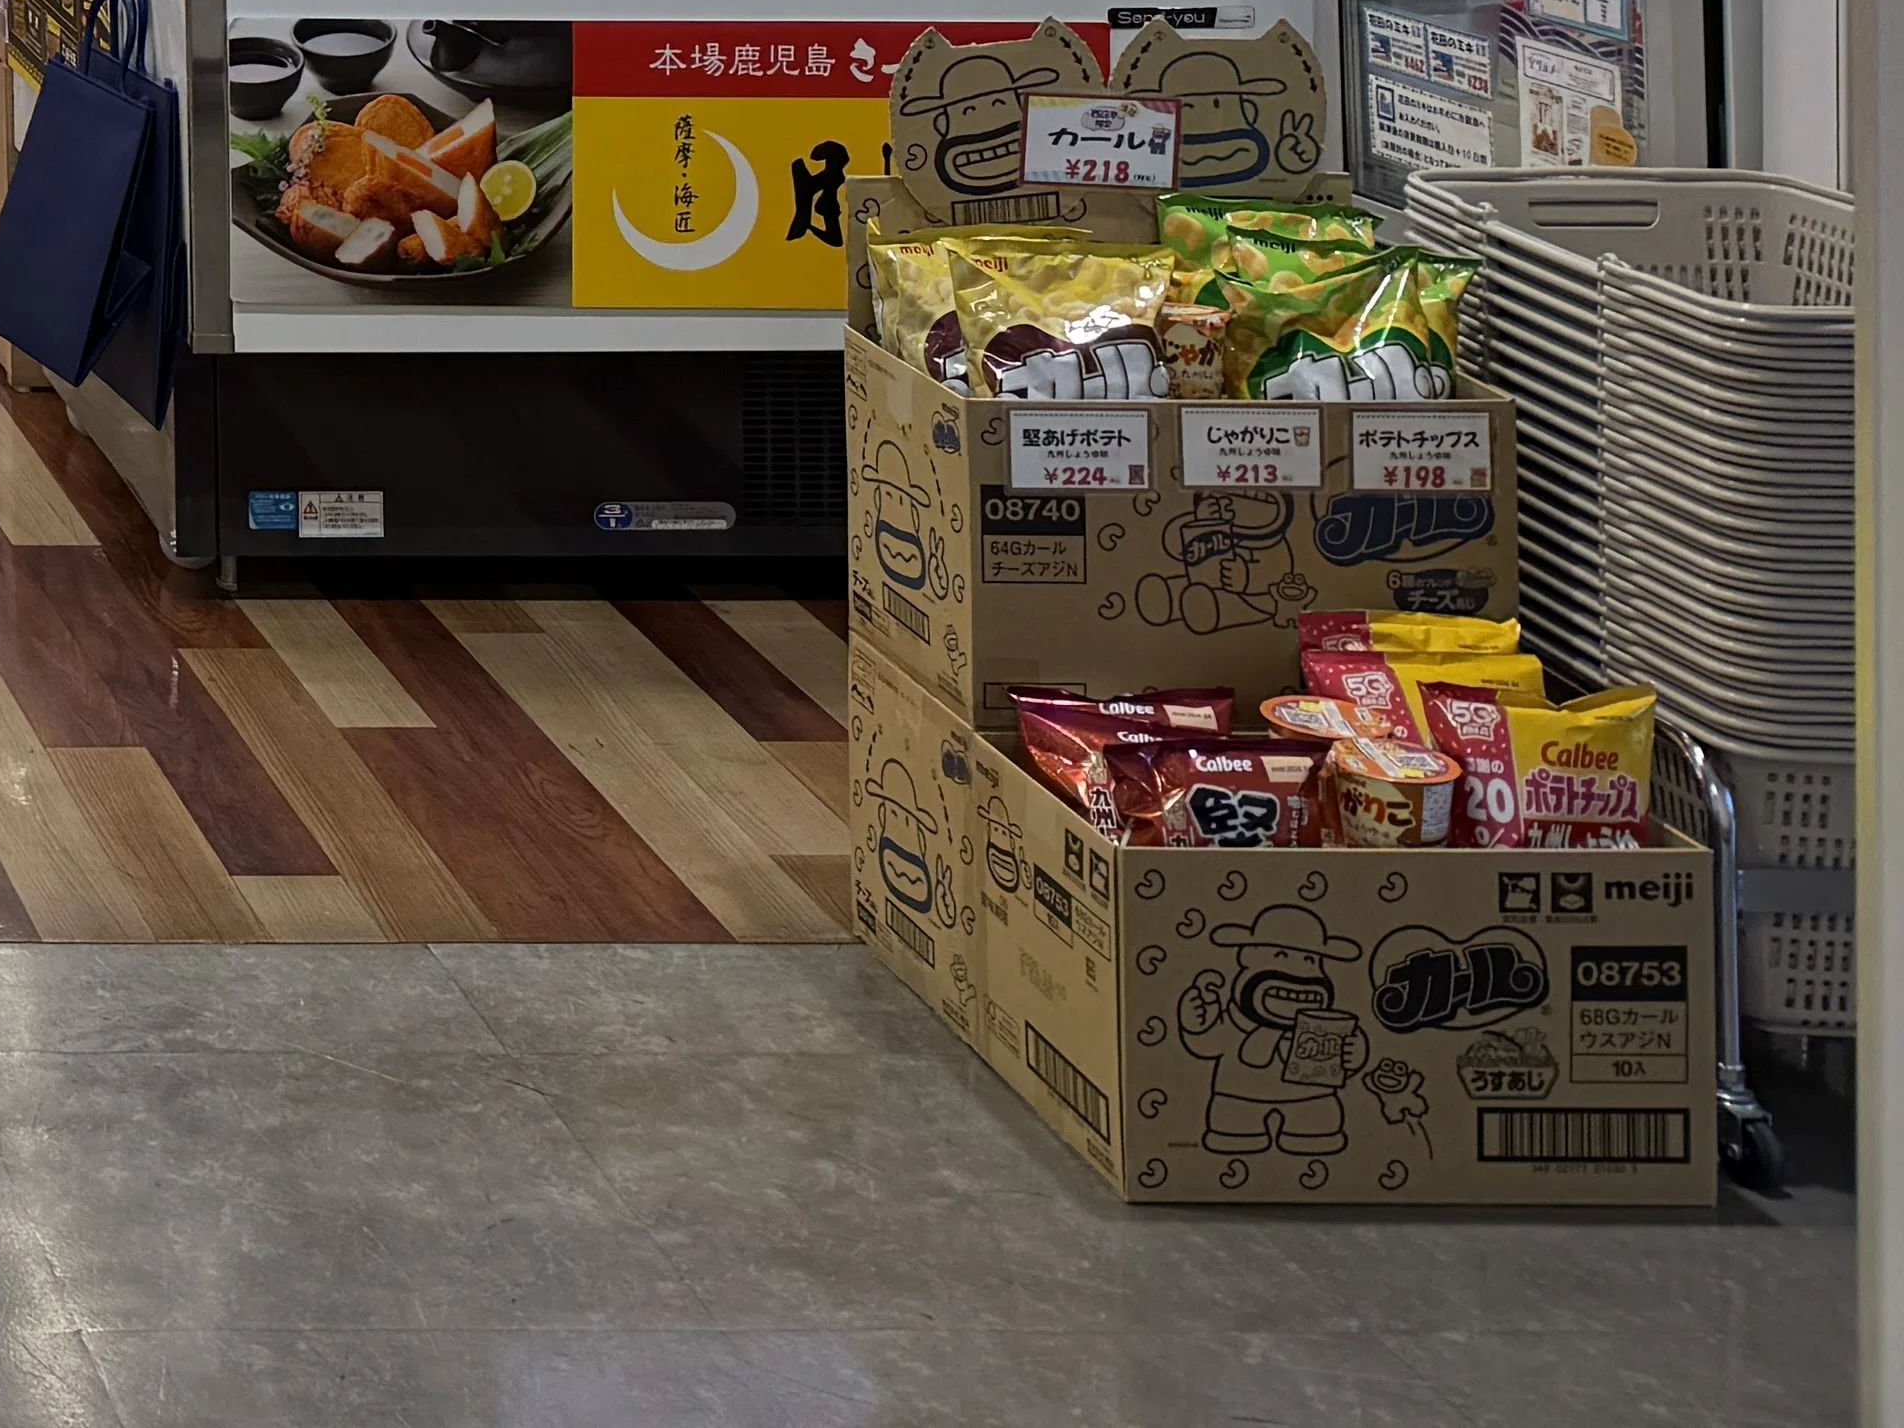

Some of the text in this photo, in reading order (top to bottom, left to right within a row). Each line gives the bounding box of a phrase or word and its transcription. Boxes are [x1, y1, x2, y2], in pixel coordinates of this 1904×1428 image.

[649, 42, 836, 78] 本場鹿児島
[1047, 125, 1146, 151] カール
[1065, 157, 1130, 185] ¥218
[1021, 427, 1132, 449] 堅あげポテト
[1206, 425, 1291, 447] じゃがりこ
[1357, 428, 1481, 450] ポテトチップス
[1044, 466, 1109, 488] ¥224
[1216, 464, 1279, 486] ¥213
[1382, 465, 1447, 490] ¥198
[984, 497, 1082, 523] 08740
[1098, 701, 1155, 717] Calbee
[1195, 755, 1253, 775] Calbee
[1540, 740, 1620, 772] Calbee
[1523, 773, 1639, 818] ポテトチップス
[1604, 872, 1693, 907] meiji
[1576, 961, 1682, 986] 08753
[1579, 1007, 1680, 1026] 68Gカール
[1580, 1031, 1672, 1050] ウスアジN
[1469, 1069, 1546, 1092] うすあじ
